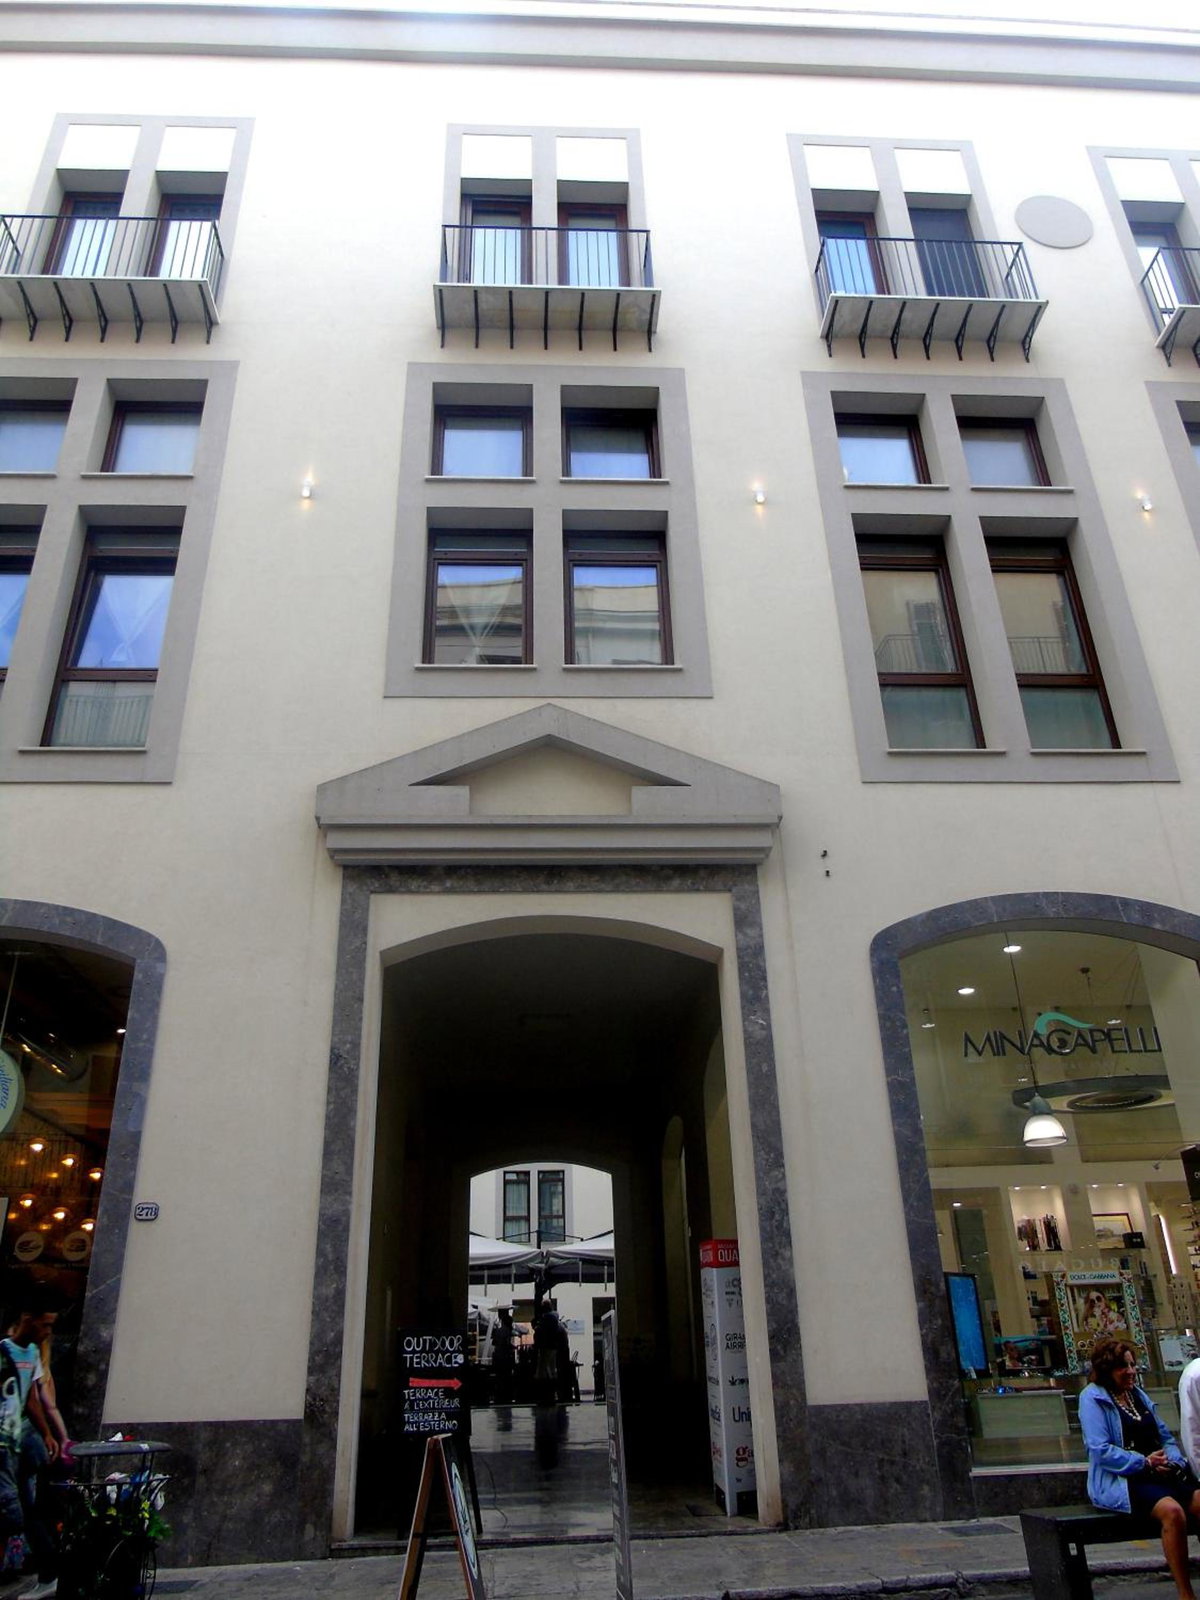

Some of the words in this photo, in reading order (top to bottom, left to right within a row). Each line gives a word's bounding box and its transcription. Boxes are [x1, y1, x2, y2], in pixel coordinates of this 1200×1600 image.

[963, 1026, 1163, 1057] MINACAPELLI
[137, 1206, 158, 1217] 278
[403, 1335, 463, 1351] OUTDOOR
[403, 1353, 461, 1368] TERRACE
[403, 1388, 445, 1399] TERRACE
[403, 1412, 447, 1422] TERRAZZA
[403, 1420, 458, 1431] ALL'ESTERNO
